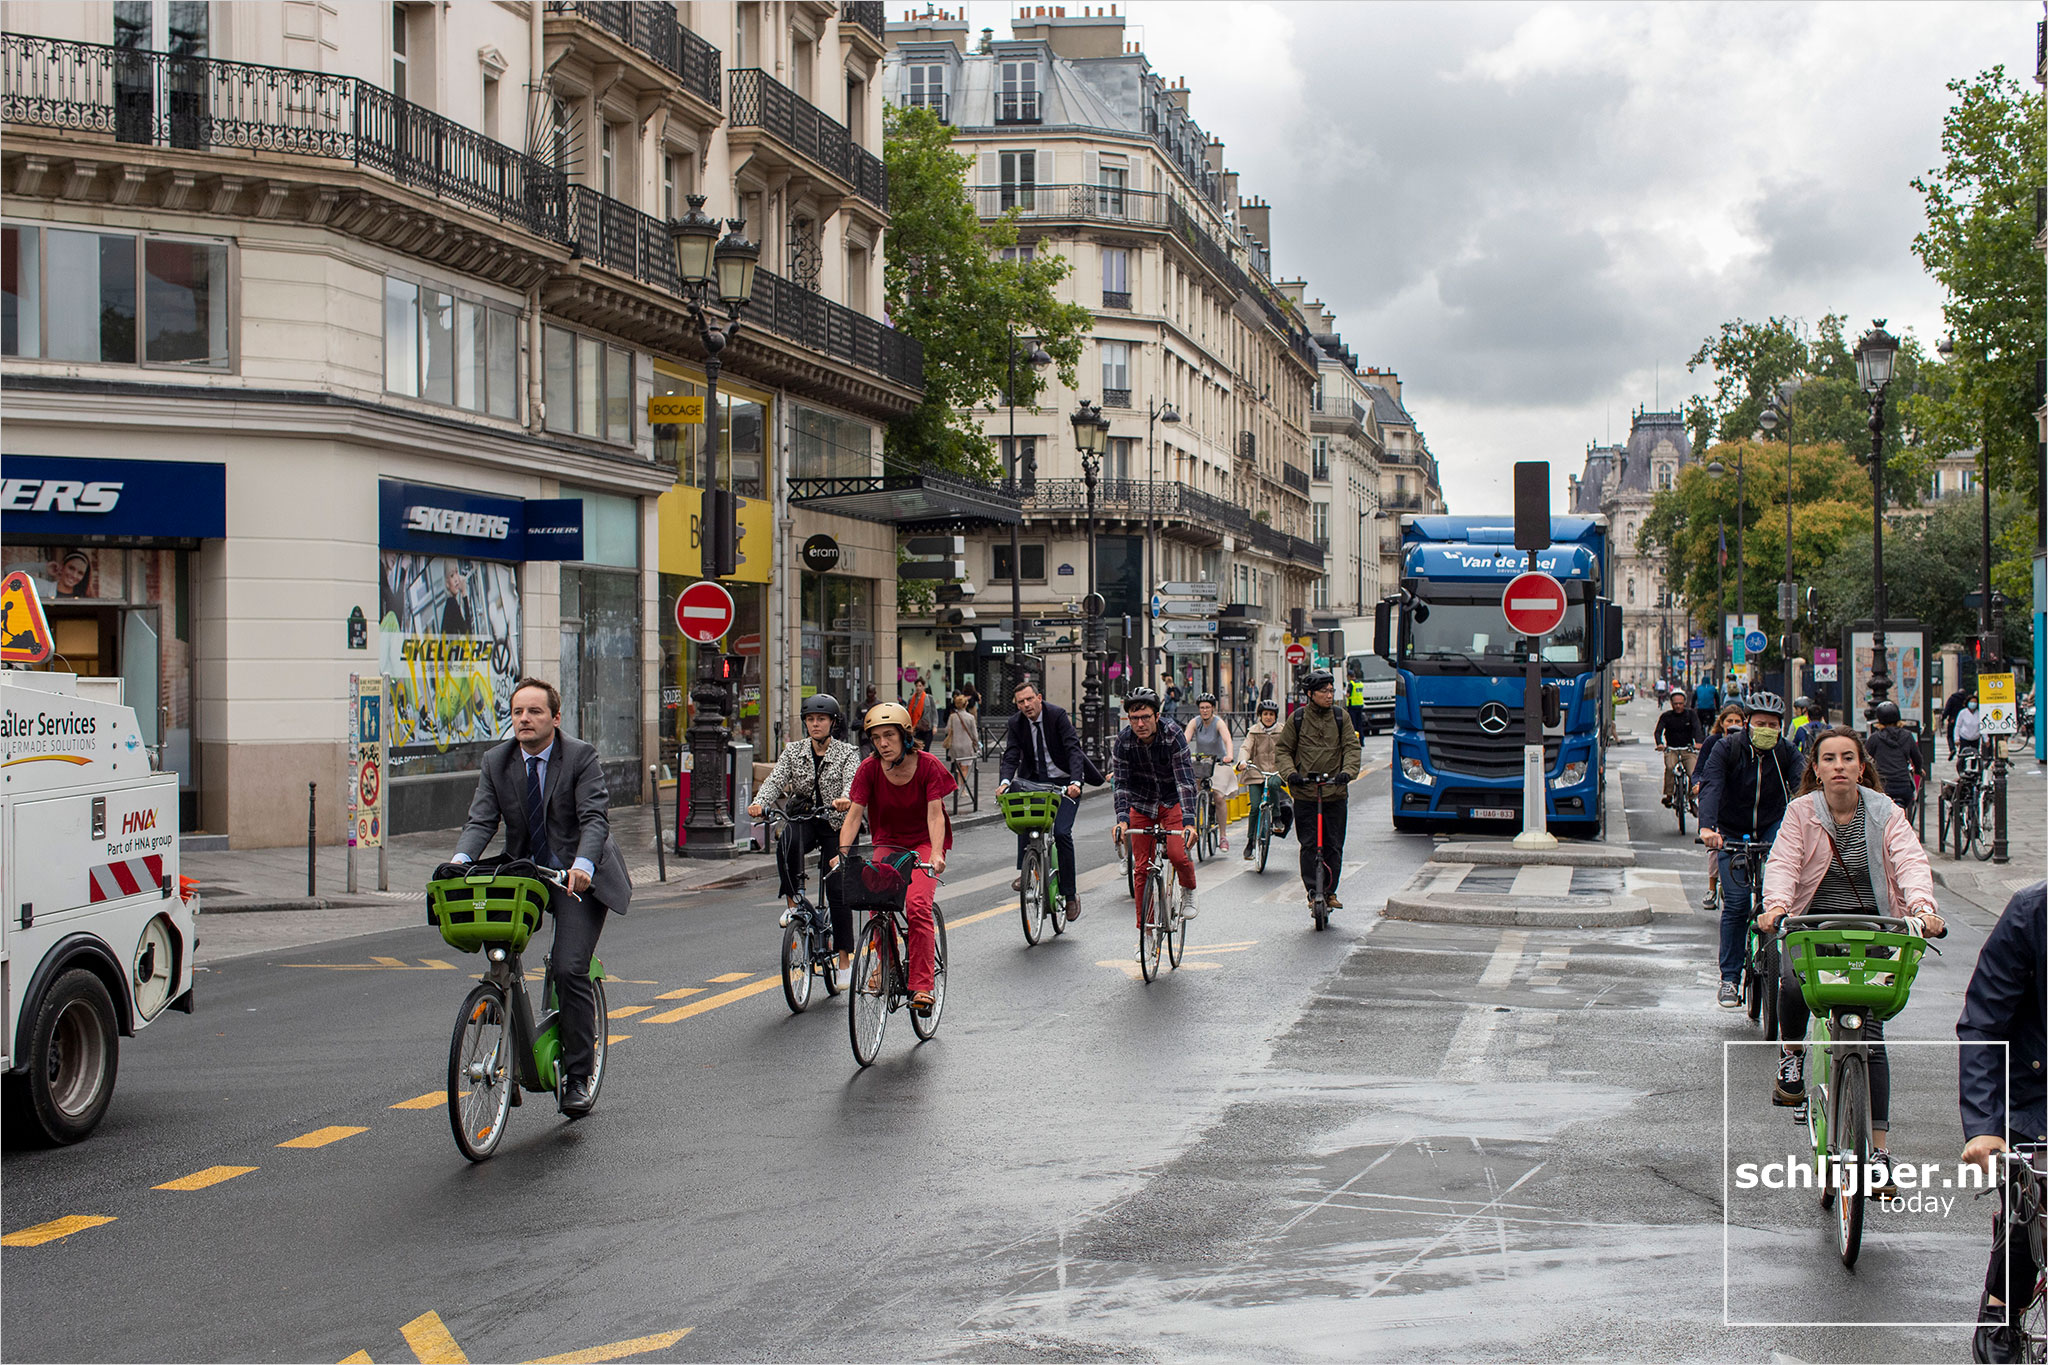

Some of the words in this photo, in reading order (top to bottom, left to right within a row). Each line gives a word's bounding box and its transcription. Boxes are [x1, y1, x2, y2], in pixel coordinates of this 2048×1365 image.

[653, 405, 702, 416] BOCAGE
[1, 479, 124, 513] ERS
[408, 506, 510, 540] SKECHERS
[528, 527, 579, 535] SKECHERS
[809, 545, 838, 558] éram
[1461, 557, 1491, 568] Van
[1495, 556, 1516, 568] de
[1519, 557, 1557, 569] Pel
[400, 639, 493, 661] SKECHERS
[991, 643, 1033, 654] minli
[1555, 679, 1575, 687] V613
[663, 690, 682, 702] SOLDES
[38, 711, 96, 736] Services
[51, 738, 96, 752] SOLUTIONS
[122, 808, 159, 835] HNA
[107, 842, 123, 856] Part
[124, 839, 134, 852] of
[134, 837, 151, 851] HNA
[151, 834, 173, 850] group
